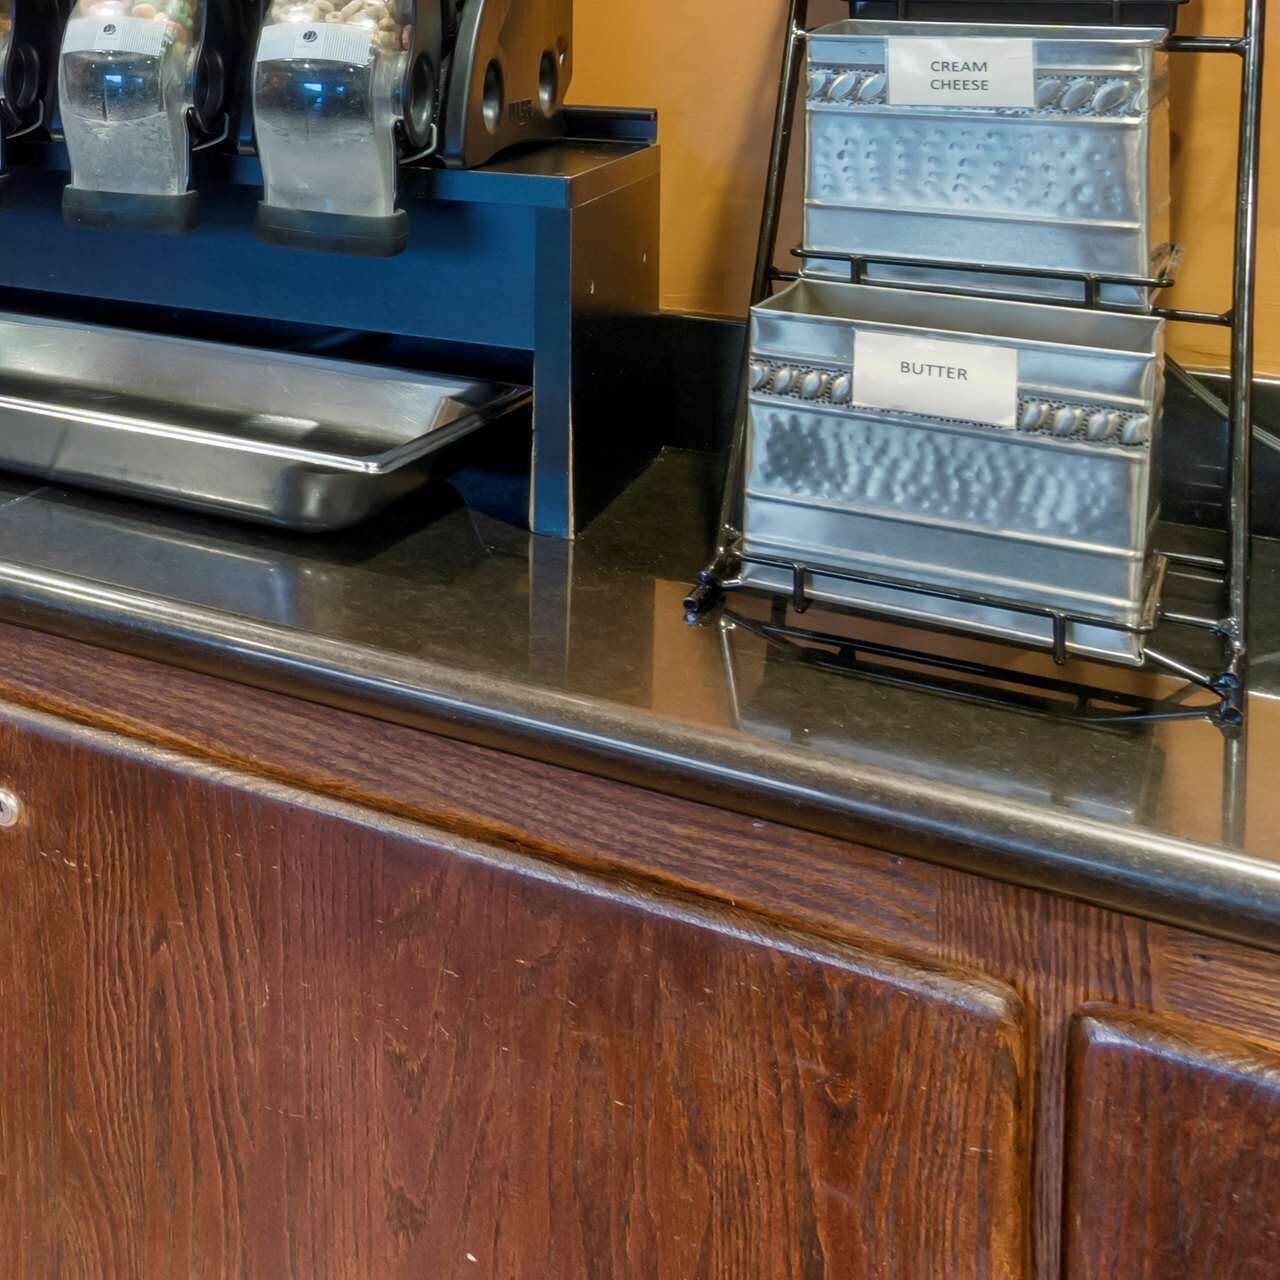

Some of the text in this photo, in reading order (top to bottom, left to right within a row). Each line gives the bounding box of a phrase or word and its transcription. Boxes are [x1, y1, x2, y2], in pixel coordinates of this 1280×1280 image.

[929, 60, 988, 73] CREAM
[929, 79, 990, 91] CHEESE
[900, 360, 969, 381] BUTTER
